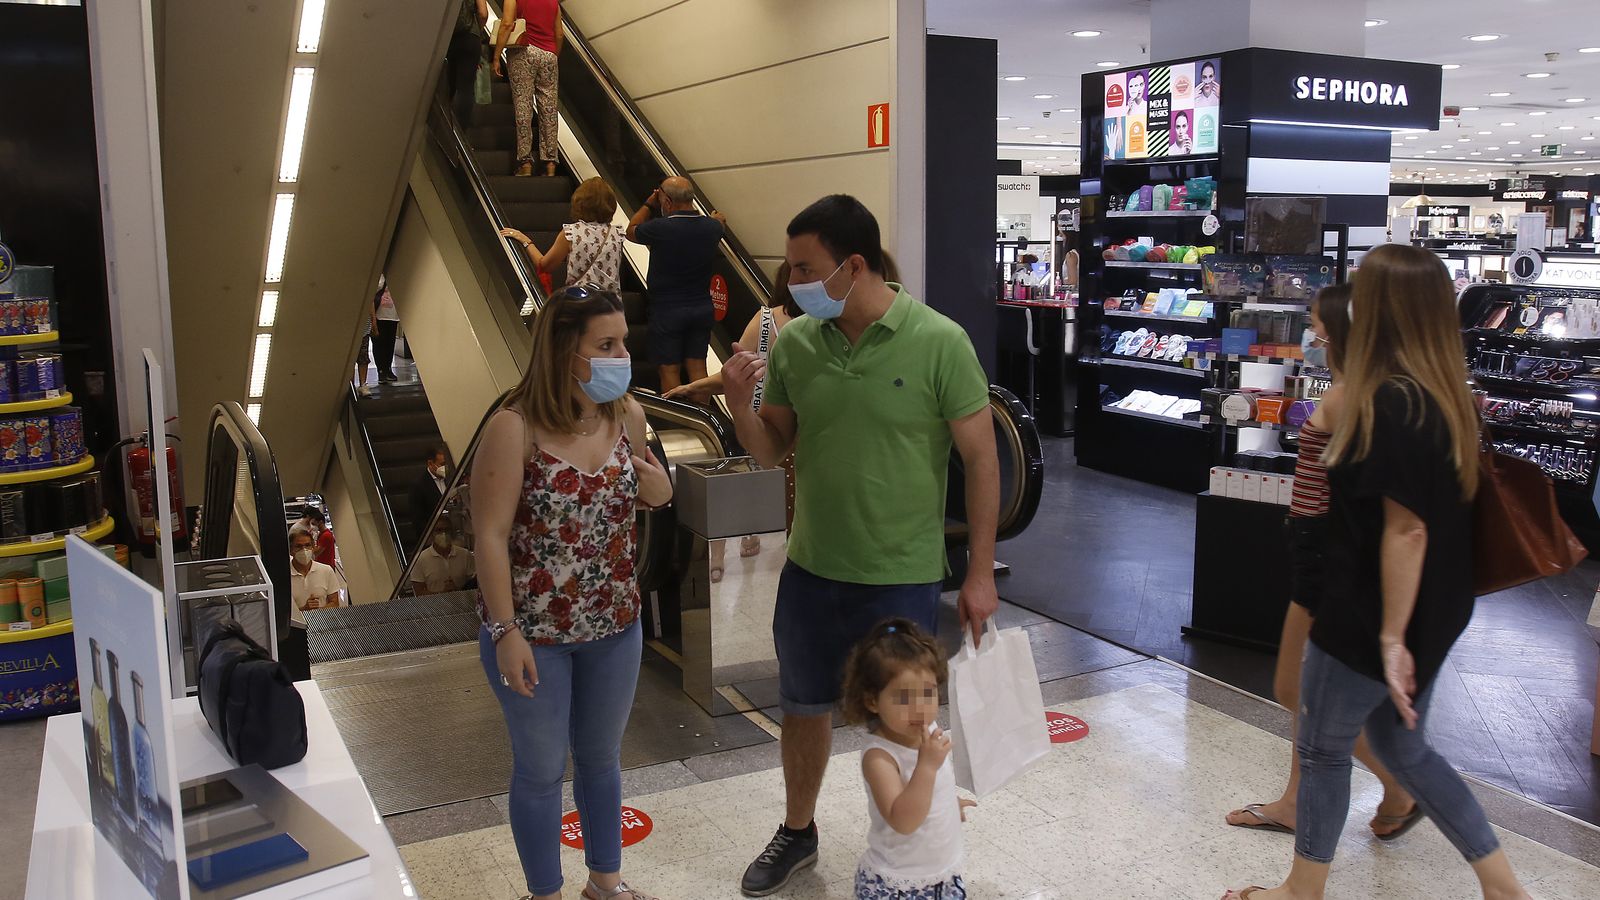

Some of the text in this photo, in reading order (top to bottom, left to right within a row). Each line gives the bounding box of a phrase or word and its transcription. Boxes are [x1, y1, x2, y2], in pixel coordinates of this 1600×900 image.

[1295, 76, 1409, 107] SEPHORA
[1489, 180, 1496, 190] B
[715, 278, 721, 290] 2
[759, 322, 770, 352] BIMBA
